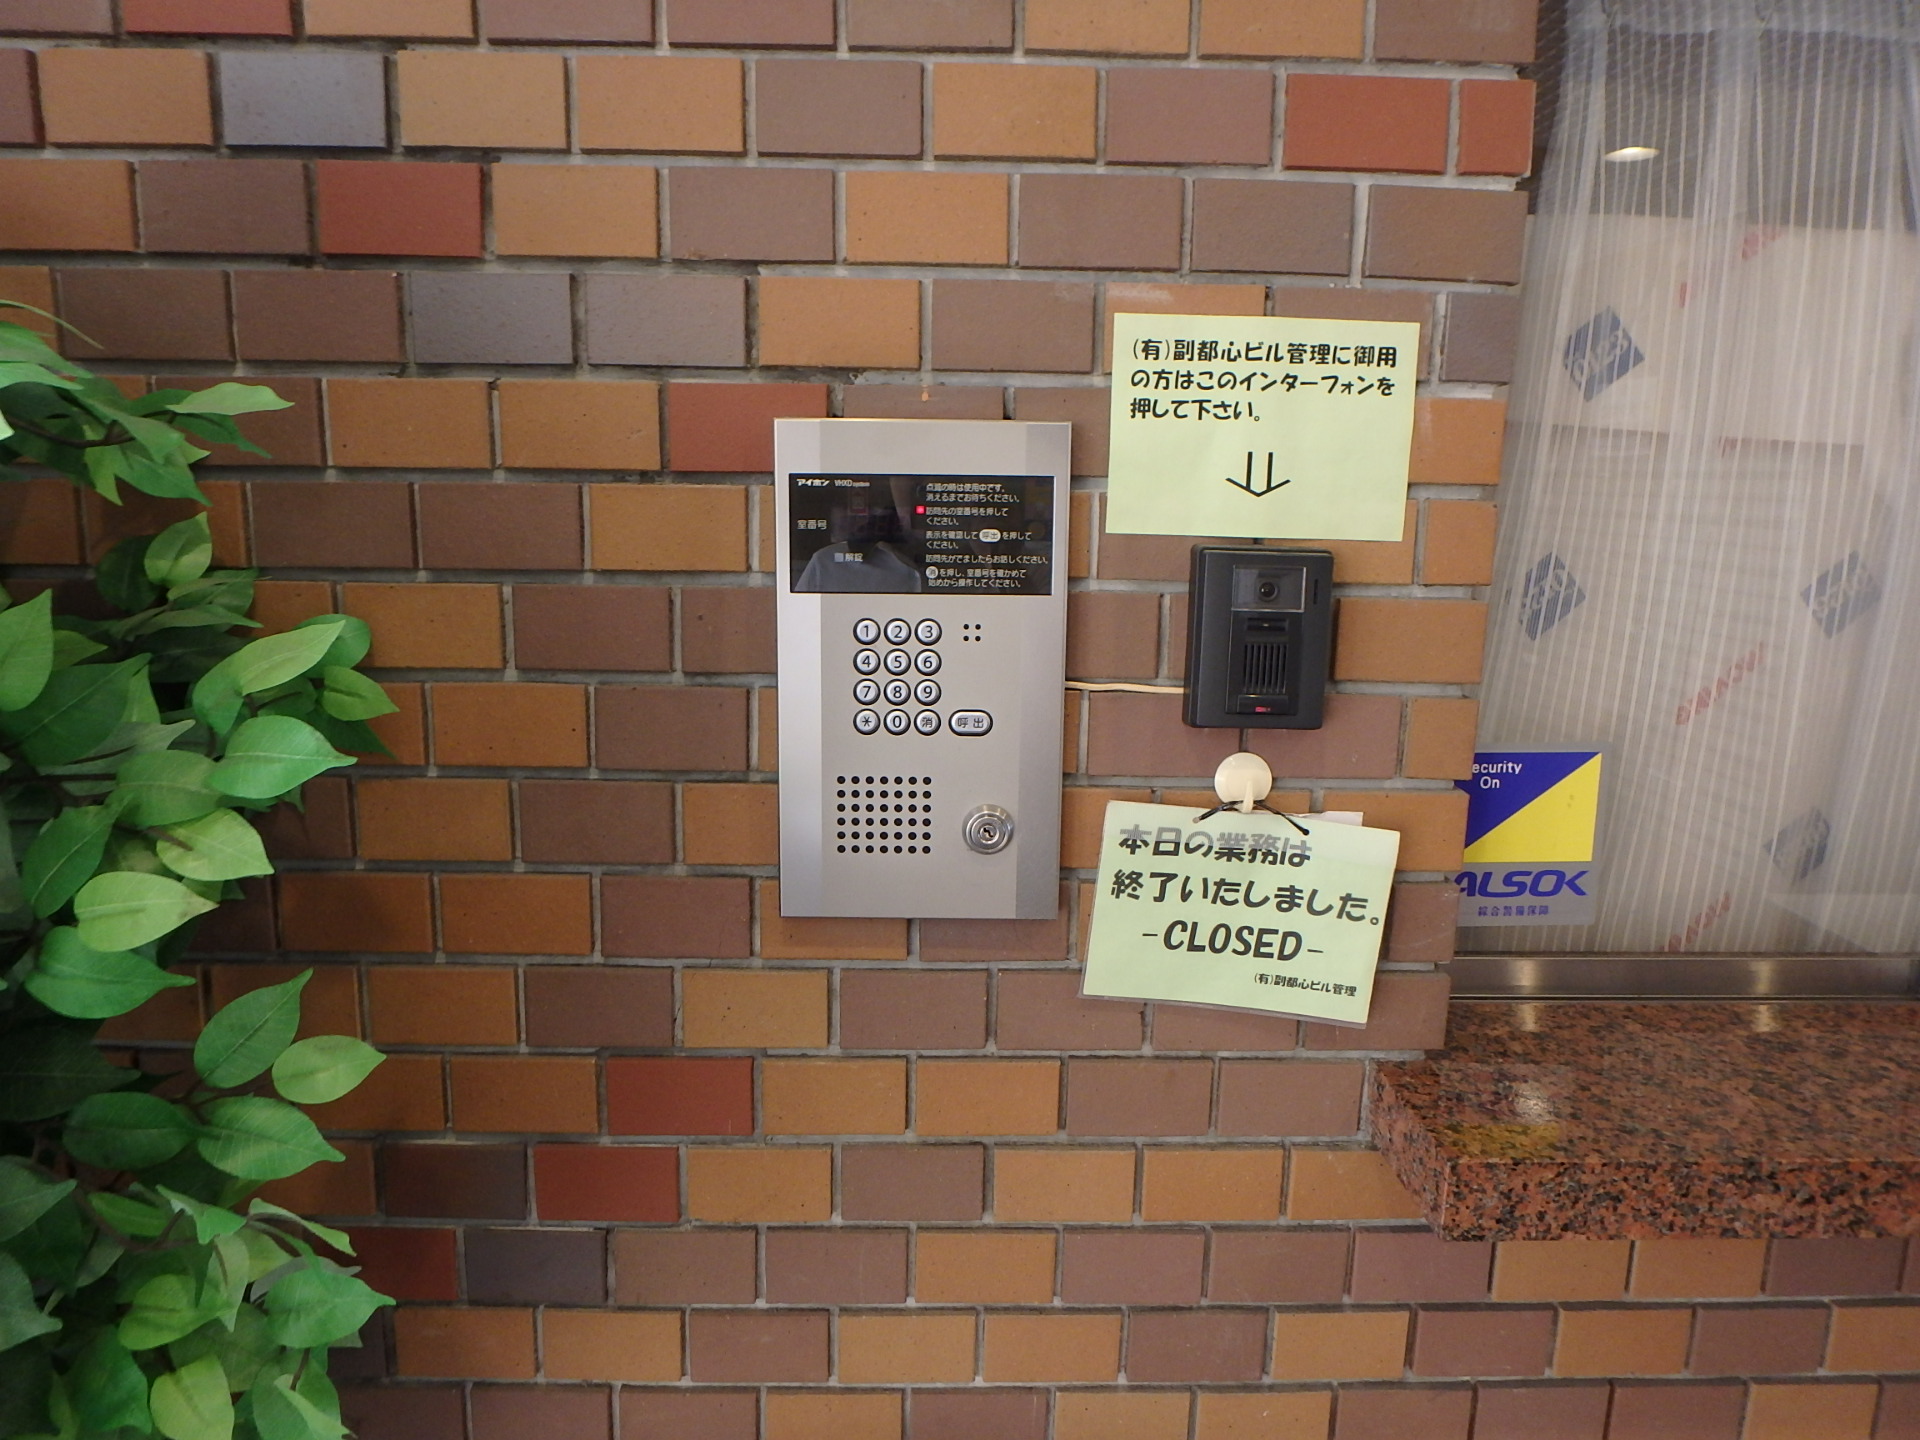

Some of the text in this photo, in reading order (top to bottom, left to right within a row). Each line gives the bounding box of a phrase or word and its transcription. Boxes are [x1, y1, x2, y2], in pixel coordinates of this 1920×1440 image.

[1132, 337, 1398, 369] (有)副都心ビル管理に御用
[1130, 367, 1396, 397] の方はこのインターフォンを
[1129, 396, 1262, 423] 押して下さい。
[796, 478, 830, 487] アイホン
[796, 519, 828, 530] 室番号
[926, 517, 960, 526] ください。
[1001, 531, 1033, 541] を押して
[926, 541, 960, 550] ください。
[863, 625, 870, 638] 1
[893, 625, 903, 639] 2
[924, 625, 933, 639] 3
[862, 655, 872, 668] 4
[893, 655, 902, 669] 5
[923, 655, 933, 669] 6
[862, 686, 872, 699] 7
[893, 685, 902, 699] 8
[923, 685, 933, 699] 9
[892, 715, 902, 729] 0
[921, 716, 934, 728] 消
[957, 717, 984, 729] 呼出
[1472, 761, 1523, 775] ecurity
[1480, 776, 1500, 789] On
[1118, 823, 1313, 868] 本日の業務は
[1454, 869, 1590, 898] ALSOK
[1110, 869, 1380, 926] 終了いたしました。
[1253, 972, 1358, 998] (有)副都心ビル管理
